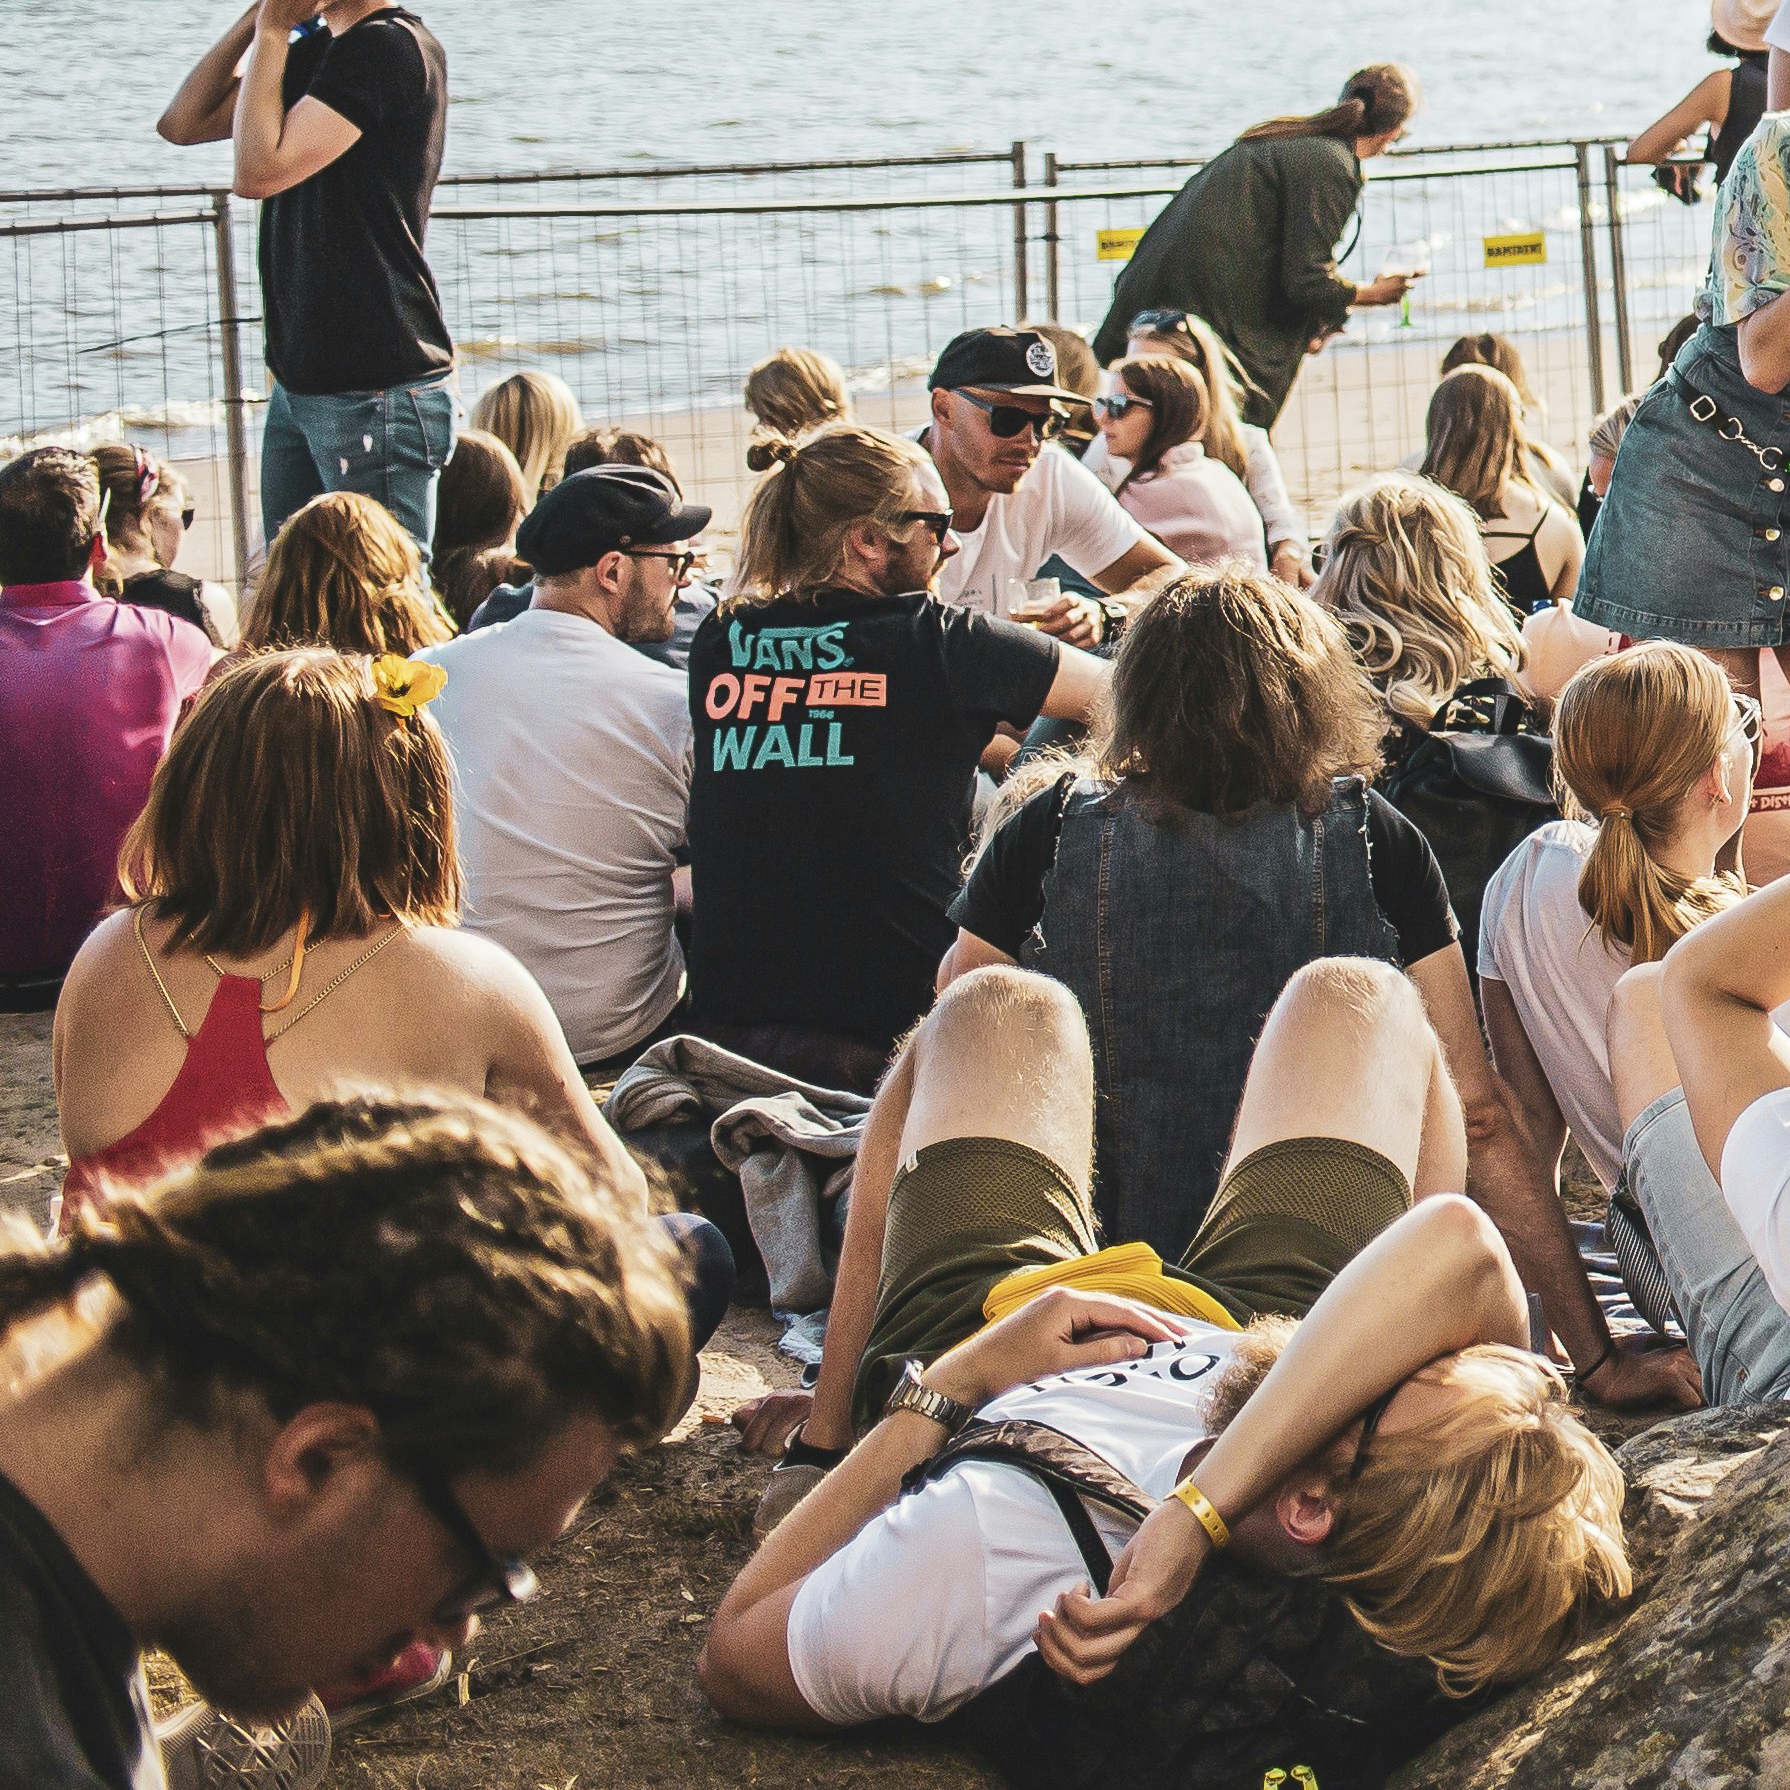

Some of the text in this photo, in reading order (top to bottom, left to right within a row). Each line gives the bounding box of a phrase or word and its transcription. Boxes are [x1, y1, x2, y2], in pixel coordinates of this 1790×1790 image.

[729, 620, 850, 670] VANS
[705, 672, 883, 722] OFF THE
[713, 722, 855, 772] WALL
